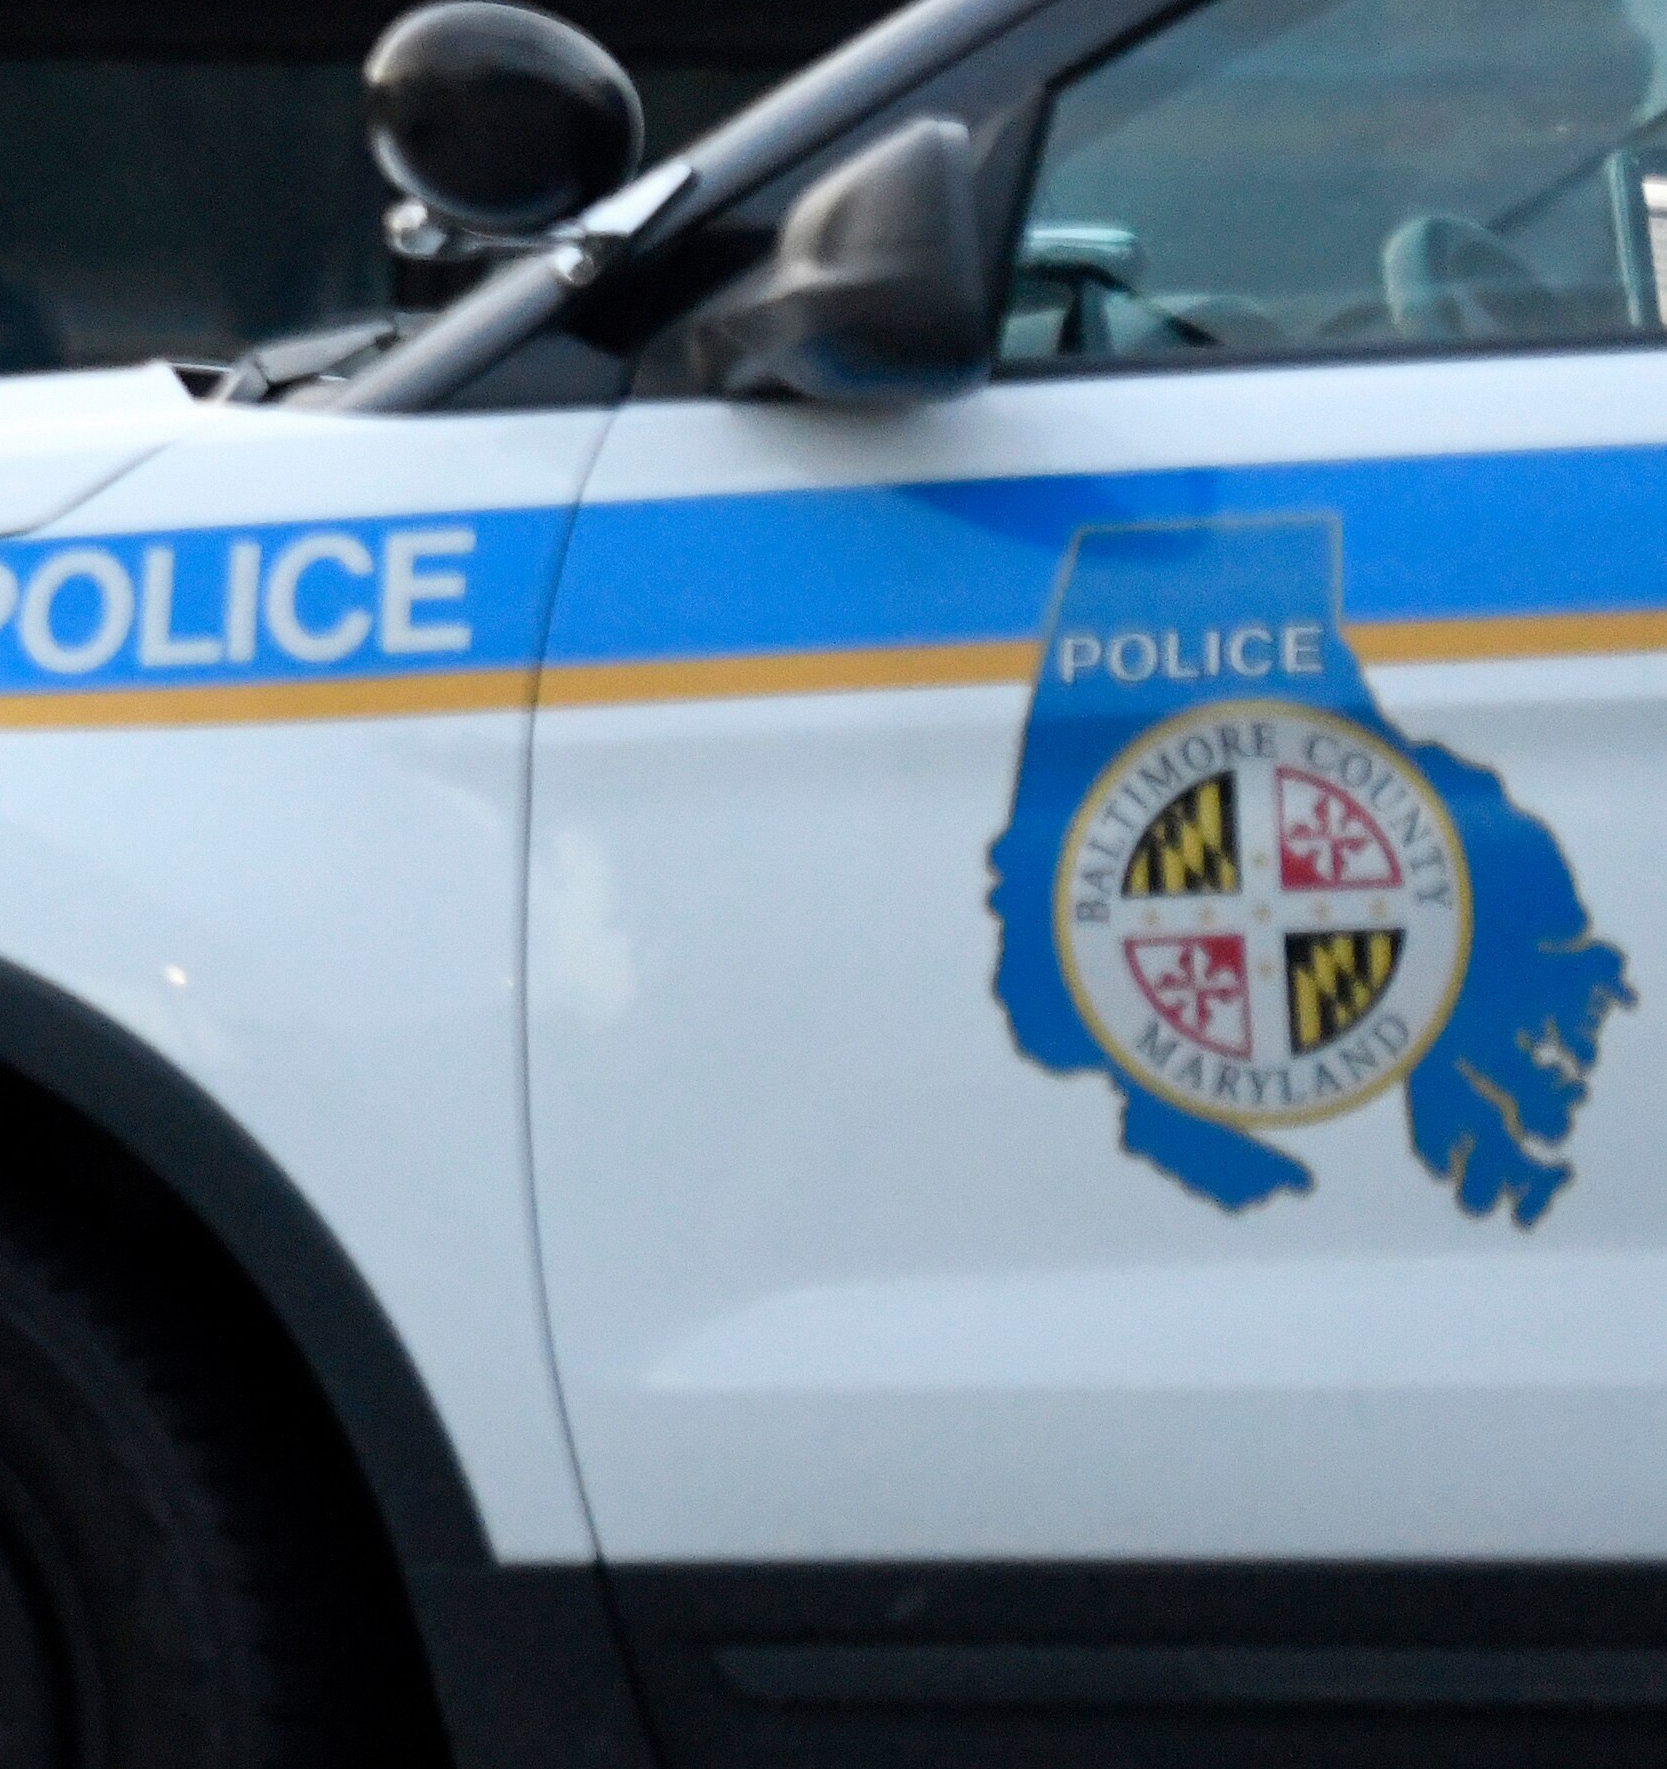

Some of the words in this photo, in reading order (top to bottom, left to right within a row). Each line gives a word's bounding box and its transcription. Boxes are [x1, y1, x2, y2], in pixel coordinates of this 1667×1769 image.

[1059, 626, 1327, 684] POLICE
[1075, 722, 1277, 924] BALTIMORE
[1305, 734, 1453, 910] COUNTY
[1135, 1012, 1413, 1108] MARYLAND
